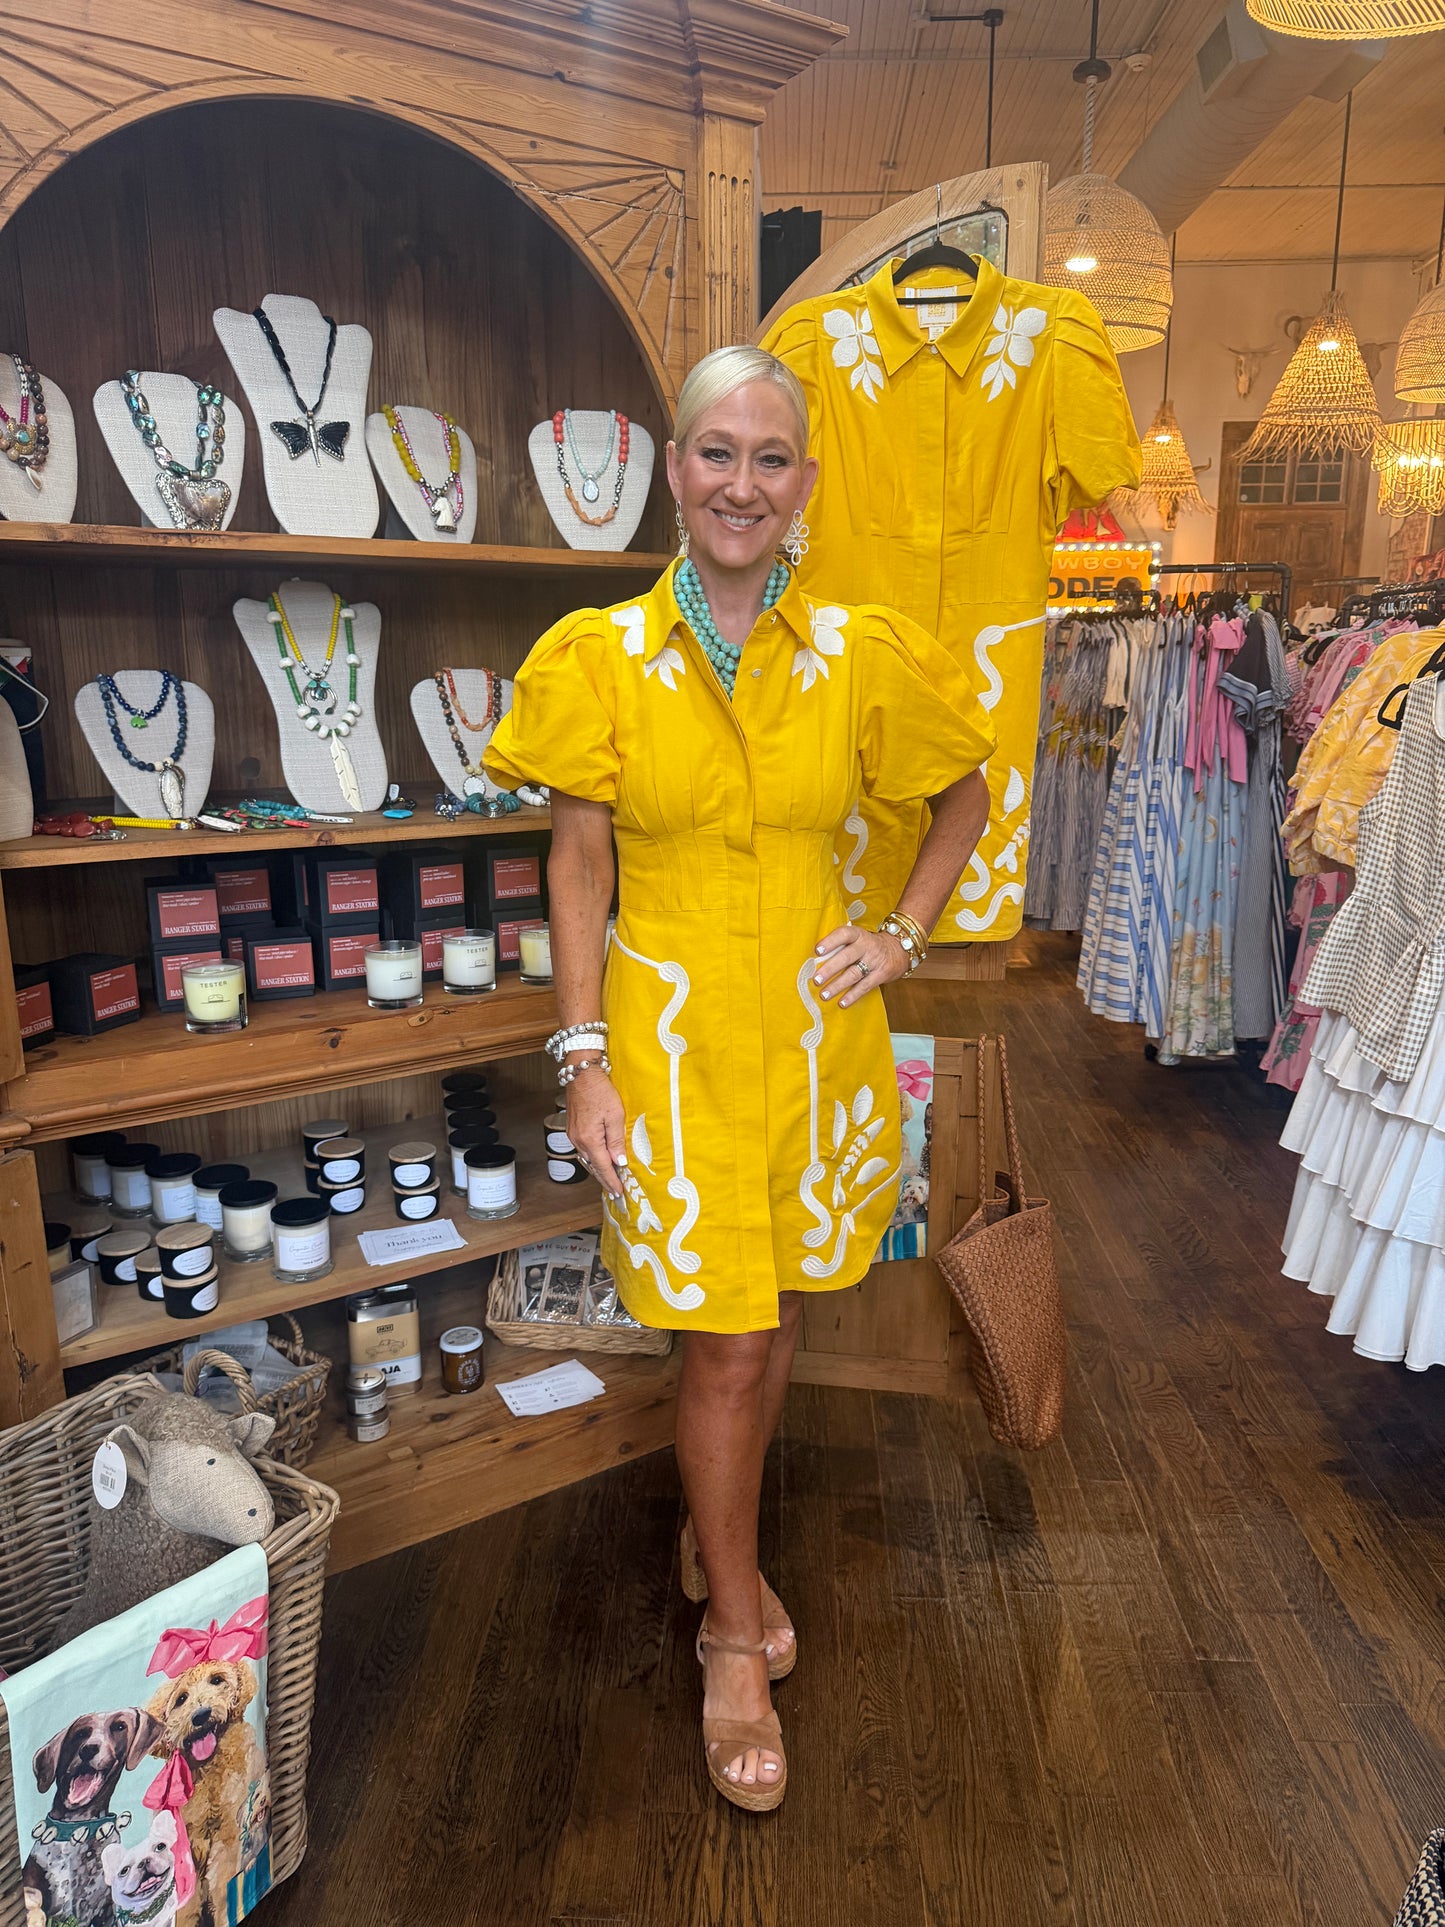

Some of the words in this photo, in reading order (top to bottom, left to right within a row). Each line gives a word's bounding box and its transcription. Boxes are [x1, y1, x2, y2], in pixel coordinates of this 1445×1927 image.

[1057, 557, 1145, 570] WBOY
[332, 901, 355, 911] RANGER
[355, 900, 378, 909] STATION
[424, 896, 443, 906] RANGER
[222, 902, 245, 912] RANGER
[245, 901, 268, 911] STATION
[165, 925, 190, 934] RANGER
[192, 923, 217, 933] STATION
[502, 950, 519, 959] RANGE
[427, 960, 443, 969] RANGE
[334, 967, 357, 976] RANGER
[200, 980, 228, 988] TESTER
[261, 977, 285, 986] RANGER
[285, 975, 310, 984] STATION
[170, 989, 184, 997] RAN
[97, 1003, 117, 1017] RANGER
[385, 1238, 420, 1247] Thank
[422, 1234, 442, 1243] you
[381, 1365, 401, 1374] AJA
